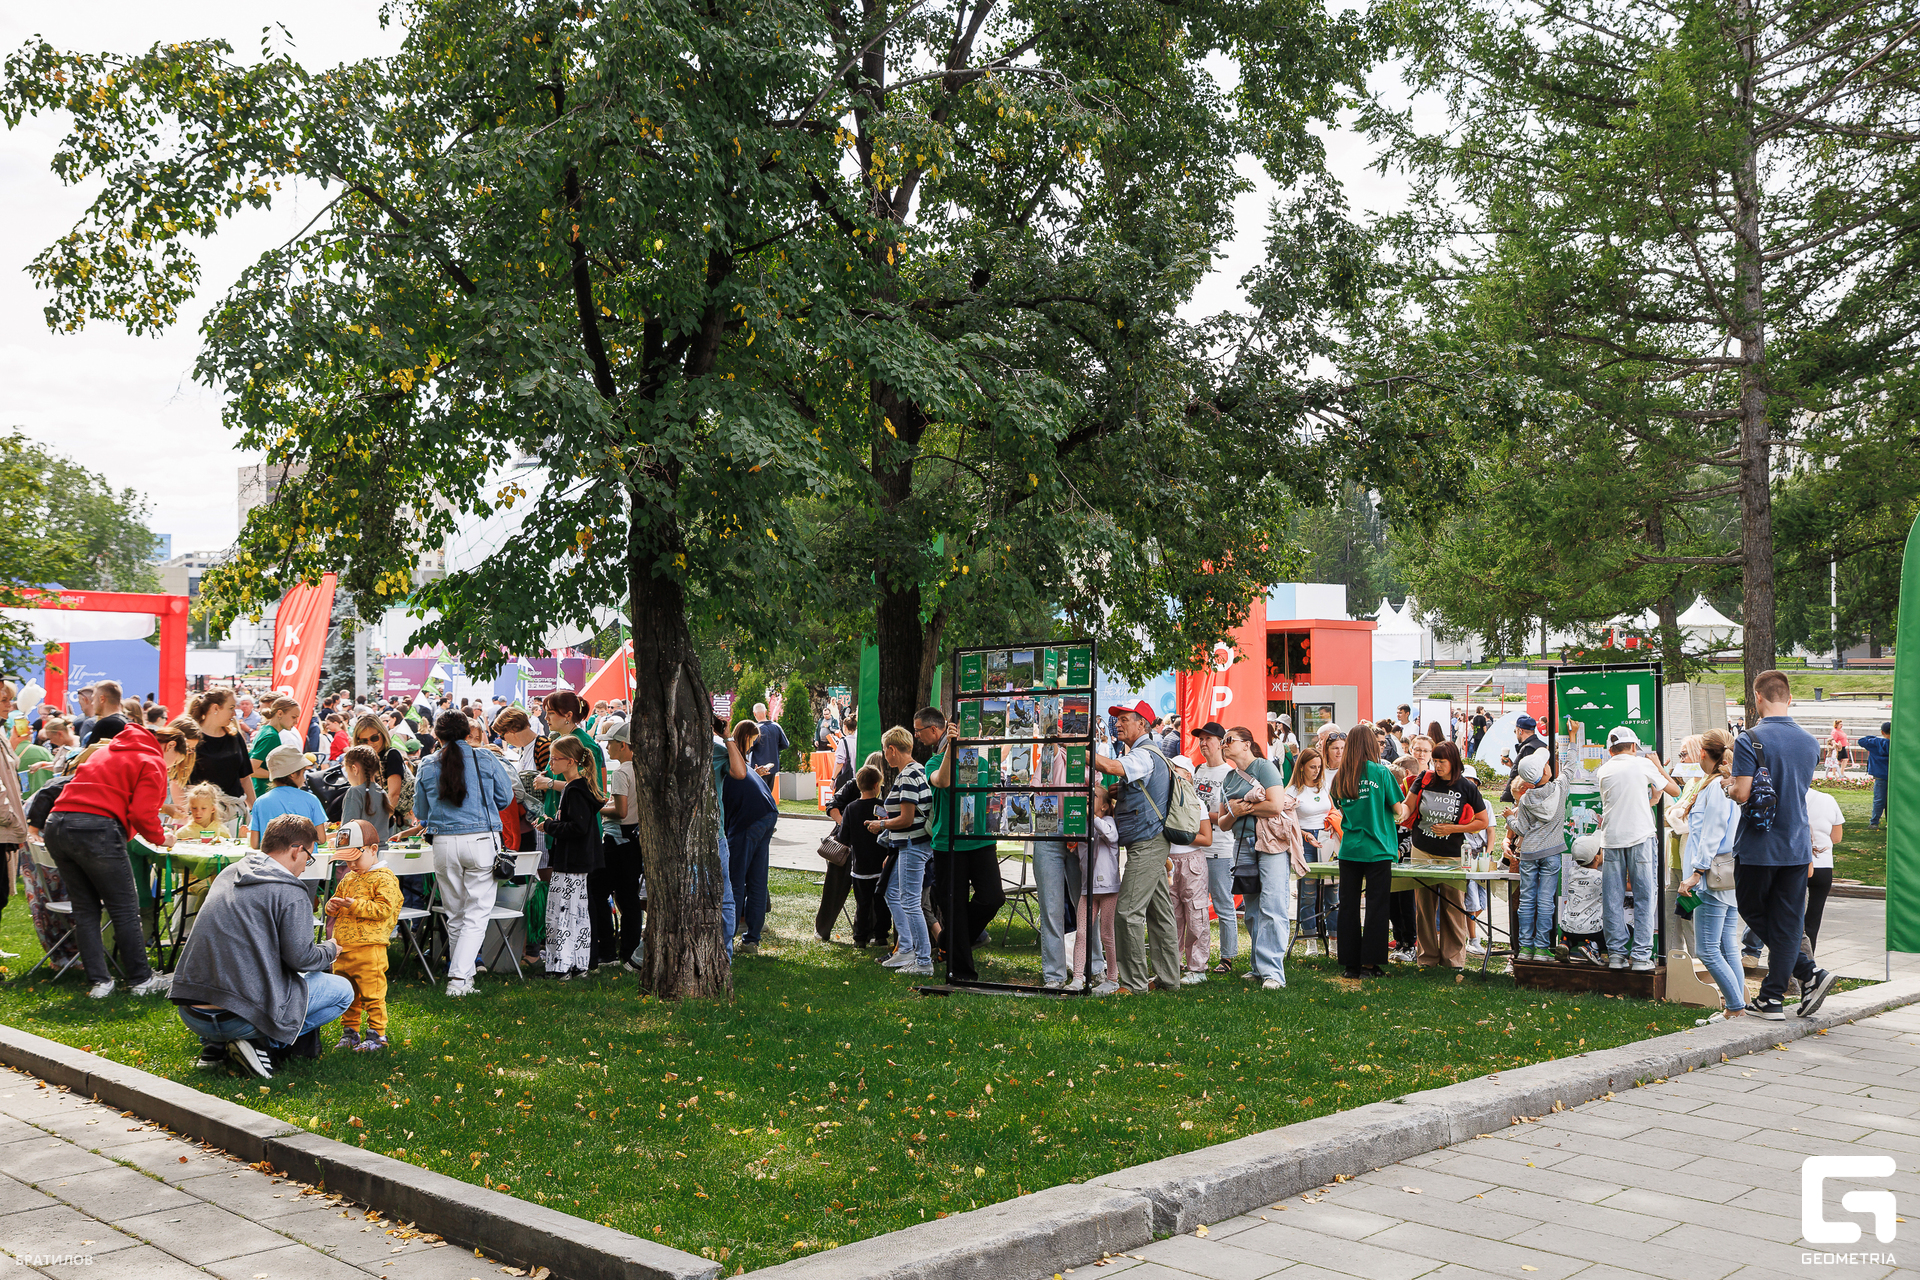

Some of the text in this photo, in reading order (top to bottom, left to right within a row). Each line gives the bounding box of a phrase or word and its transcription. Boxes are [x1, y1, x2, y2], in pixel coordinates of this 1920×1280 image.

[1449, 790, 1462, 799] DO
[1434, 796, 1460, 806] MORE
[1447, 806, 1459, 814] OF
[1429, 810, 1458, 822] WHAT
